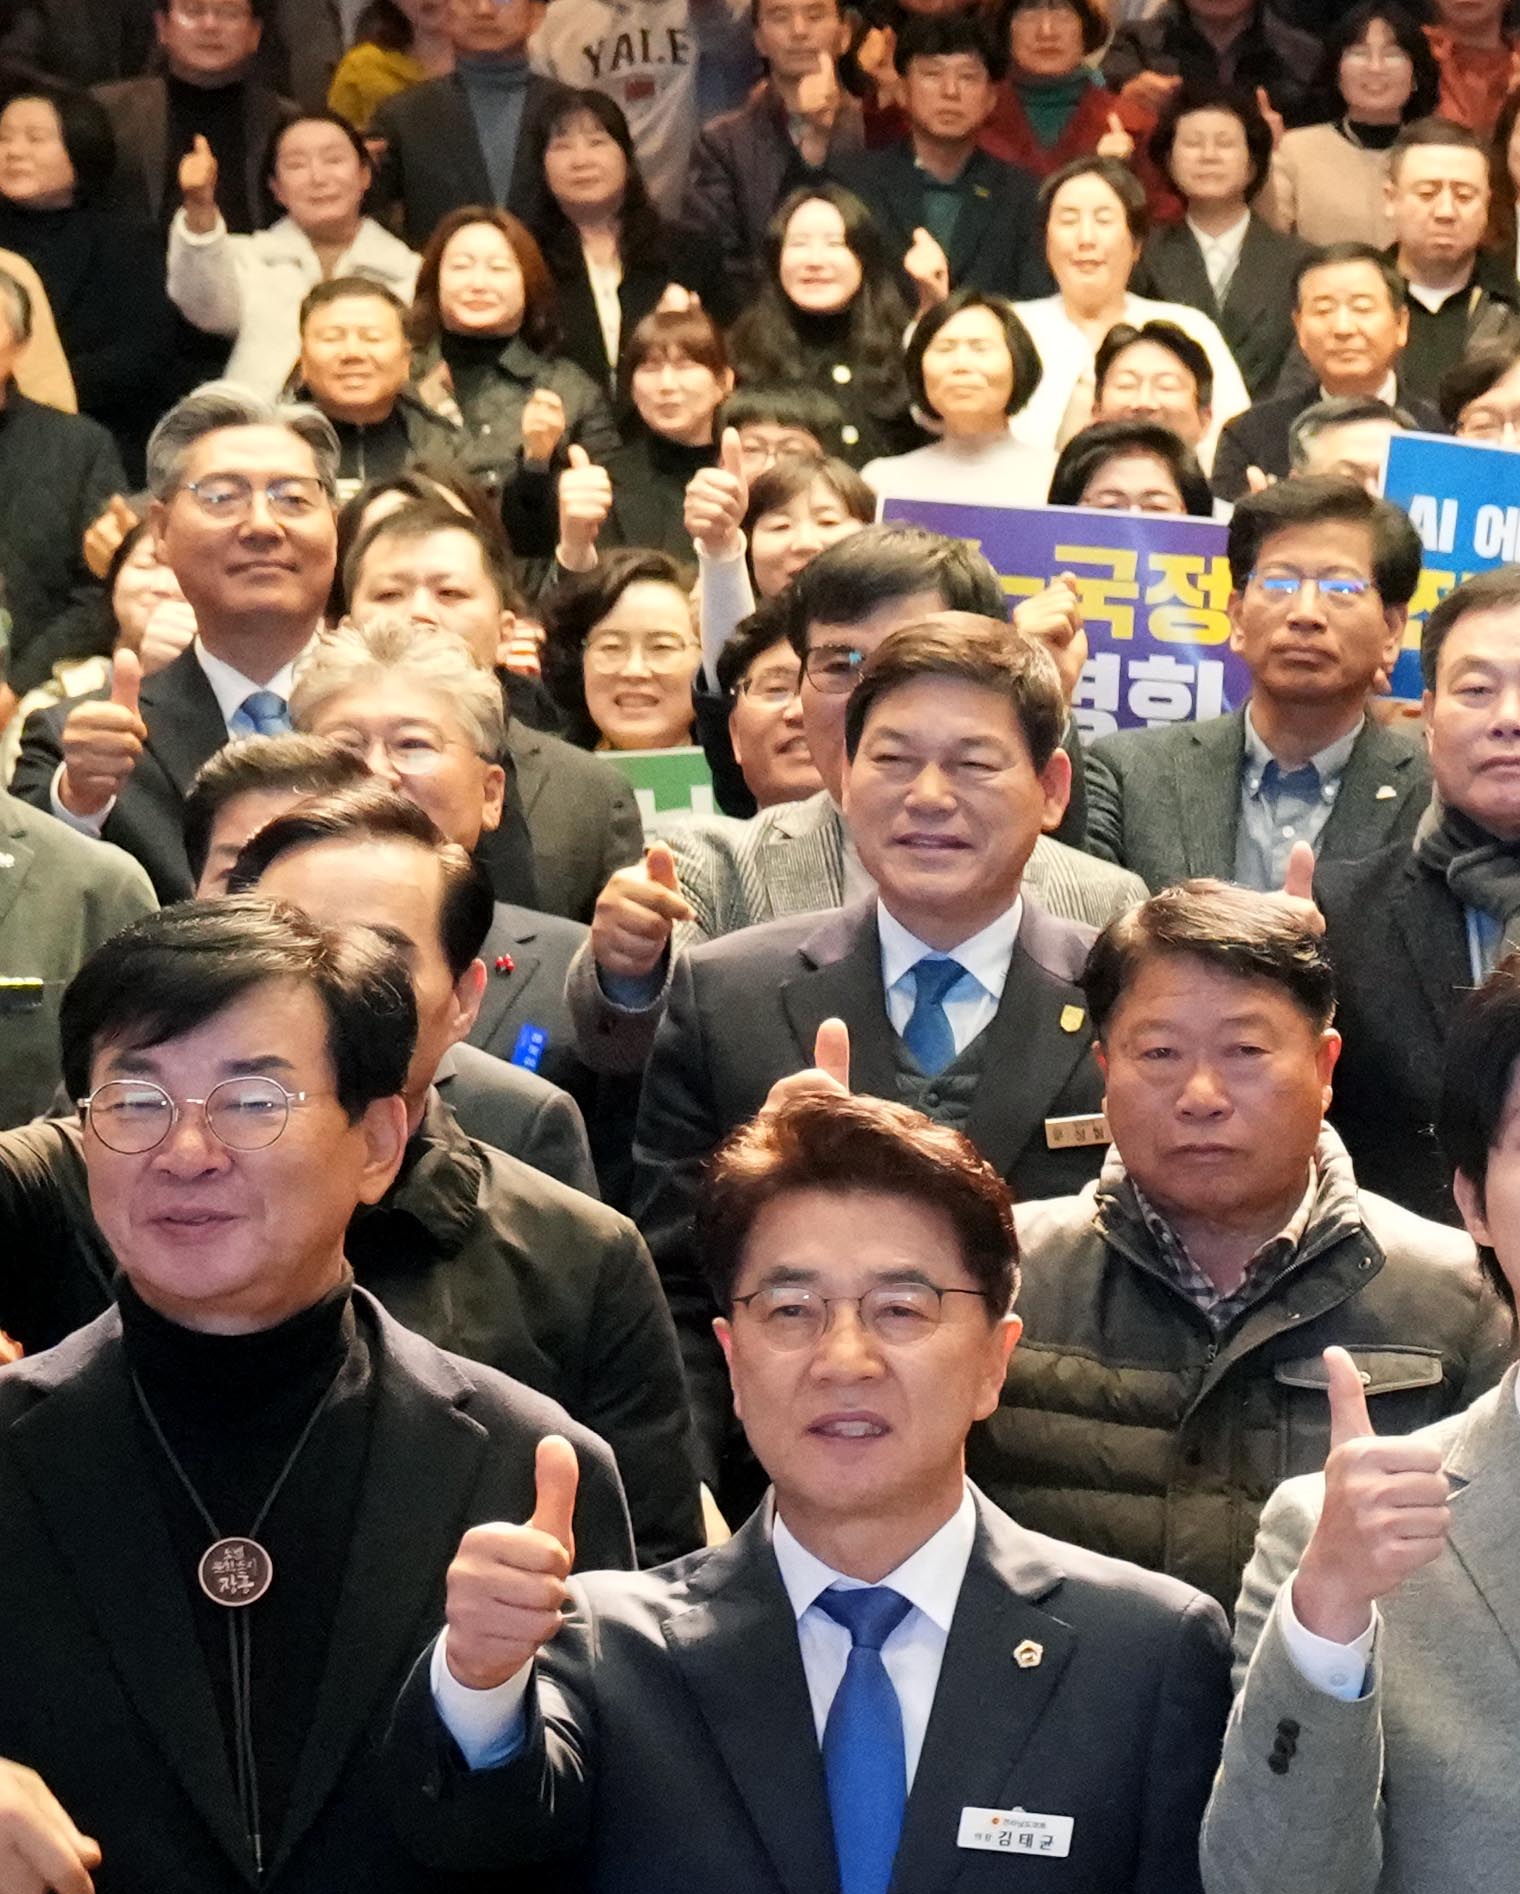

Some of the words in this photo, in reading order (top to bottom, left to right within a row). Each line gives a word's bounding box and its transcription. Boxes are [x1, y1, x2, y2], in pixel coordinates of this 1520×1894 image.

[583, 28, 689, 78] YALE
[1408, 494, 1458, 553] AI
[998, 1831, 1054, 1851] 김태균
